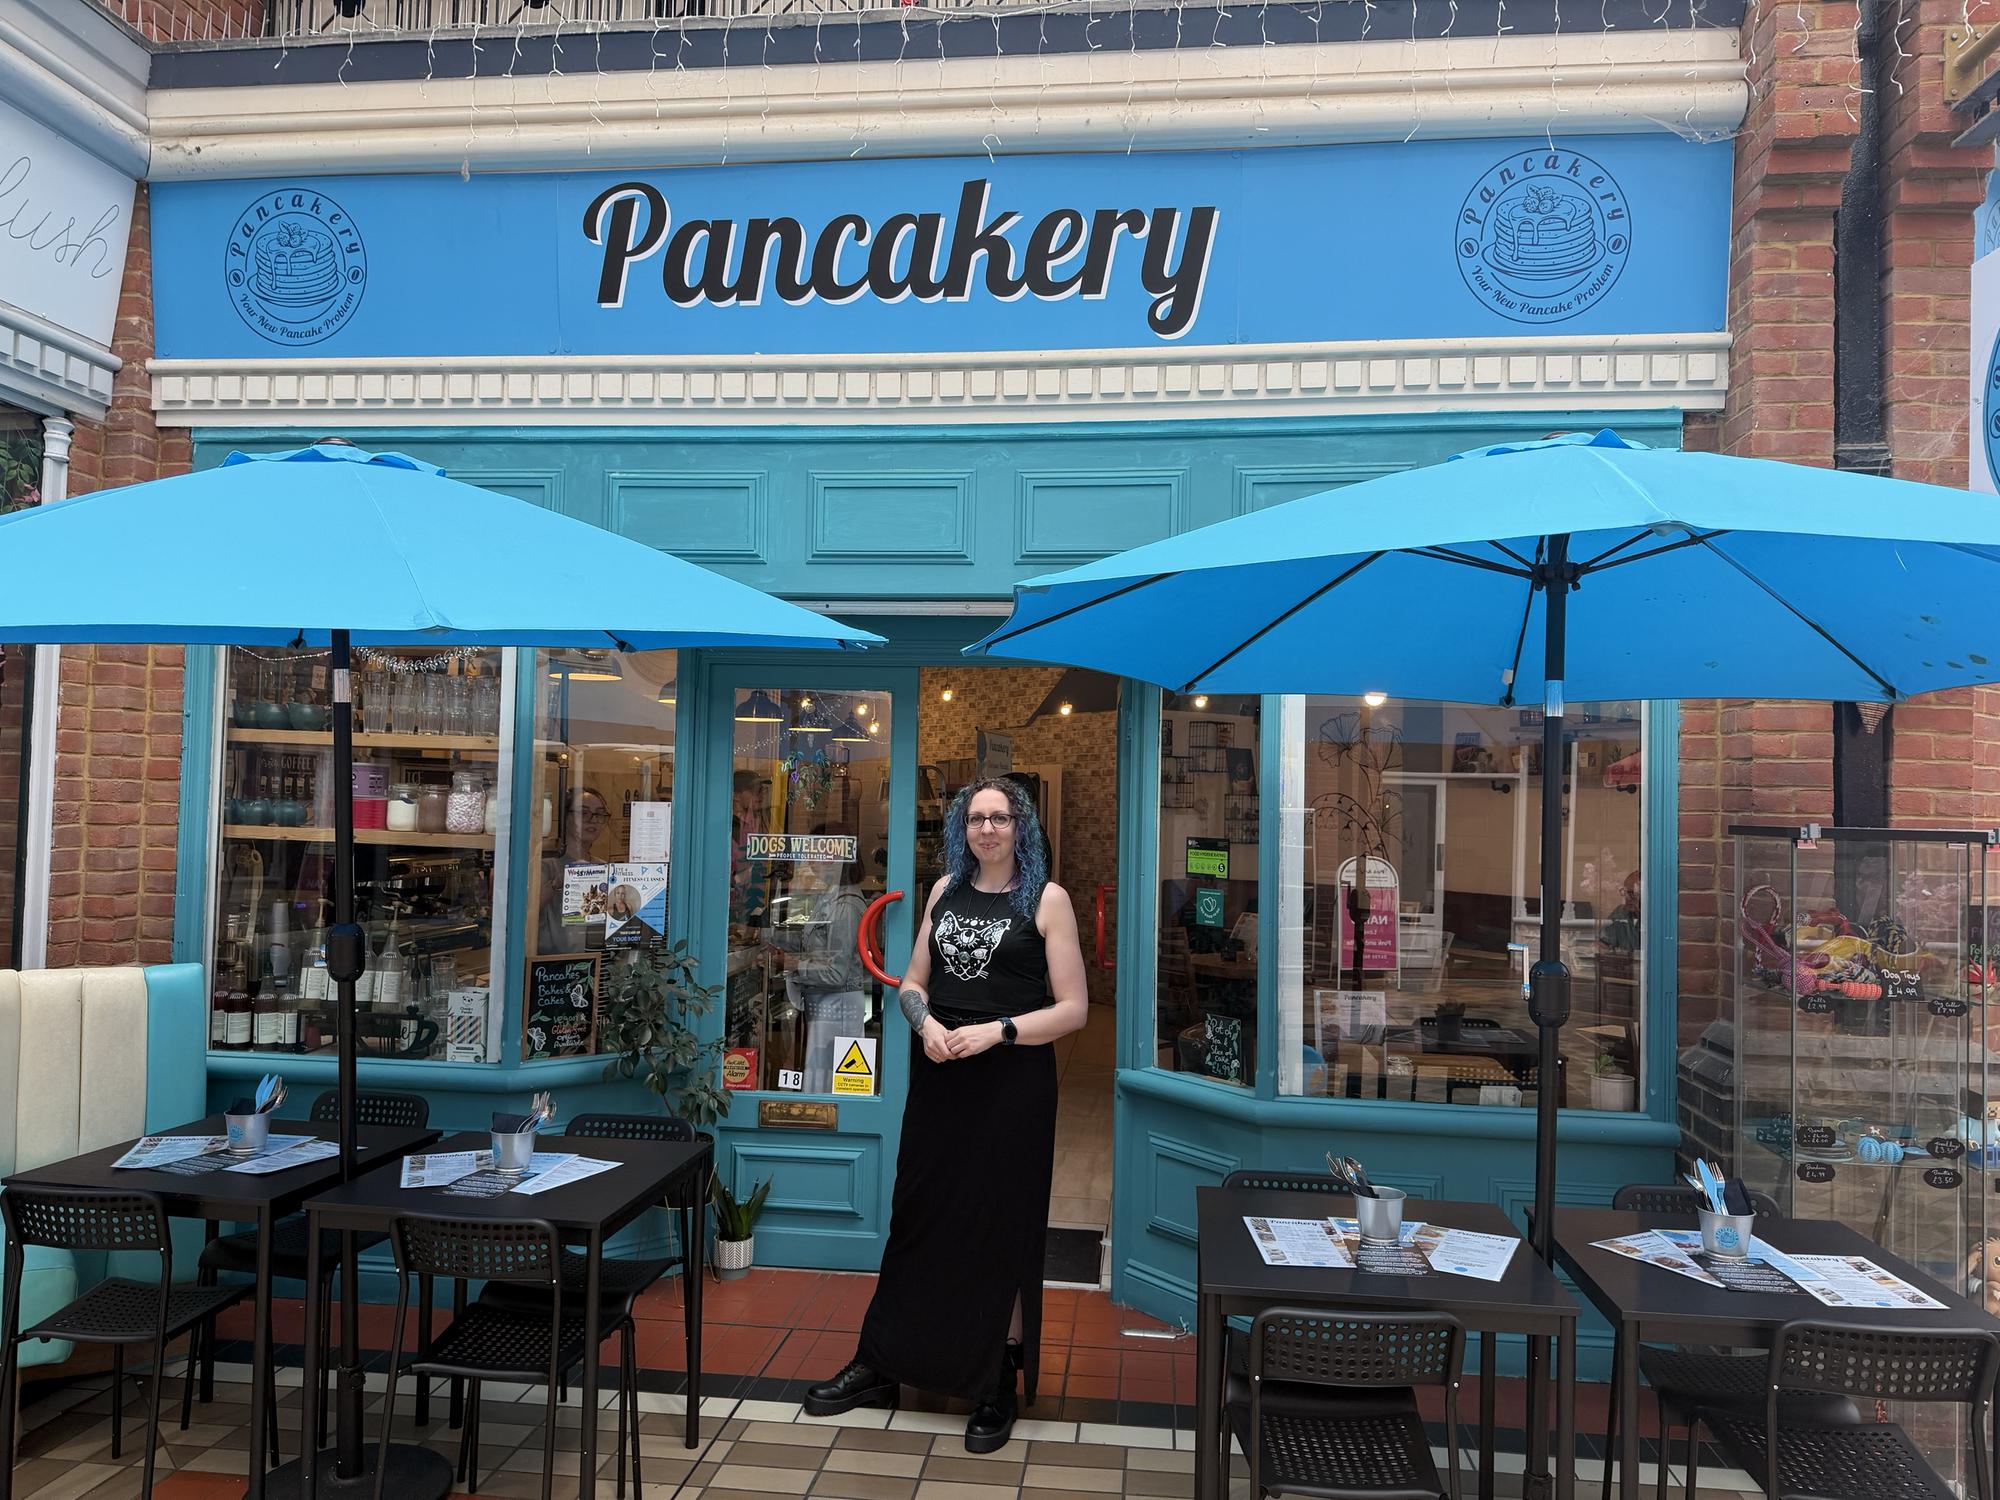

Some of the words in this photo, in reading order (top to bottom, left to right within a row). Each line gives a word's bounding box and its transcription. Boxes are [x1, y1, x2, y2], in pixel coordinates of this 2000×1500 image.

[1463, 153, 1625, 226] Pancakery
[230, 193, 361, 258] Pancakery
[582, 178, 1221, 339] Pancakery
[1471, 264, 1493, 293] Your
[1493, 289, 1518, 311] New
[1519, 301, 1574, 316] Pancake
[1573, 263, 1614, 306] Problem
[239, 293, 259, 318] Your
[258, 314, 279, 334] New
[279, 325, 324, 340] Pancake
[323, 292, 355, 330] Problem
[750, 836, 786, 856] DOGS
[790, 837, 854, 859] WELCOME
[1881, 969, 1901, 985] Dog
[1902, 969, 1921, 985] Toys
[726, 1070, 746, 1078] Alarm
[1932, 1176, 1954, 1185] £3.50
